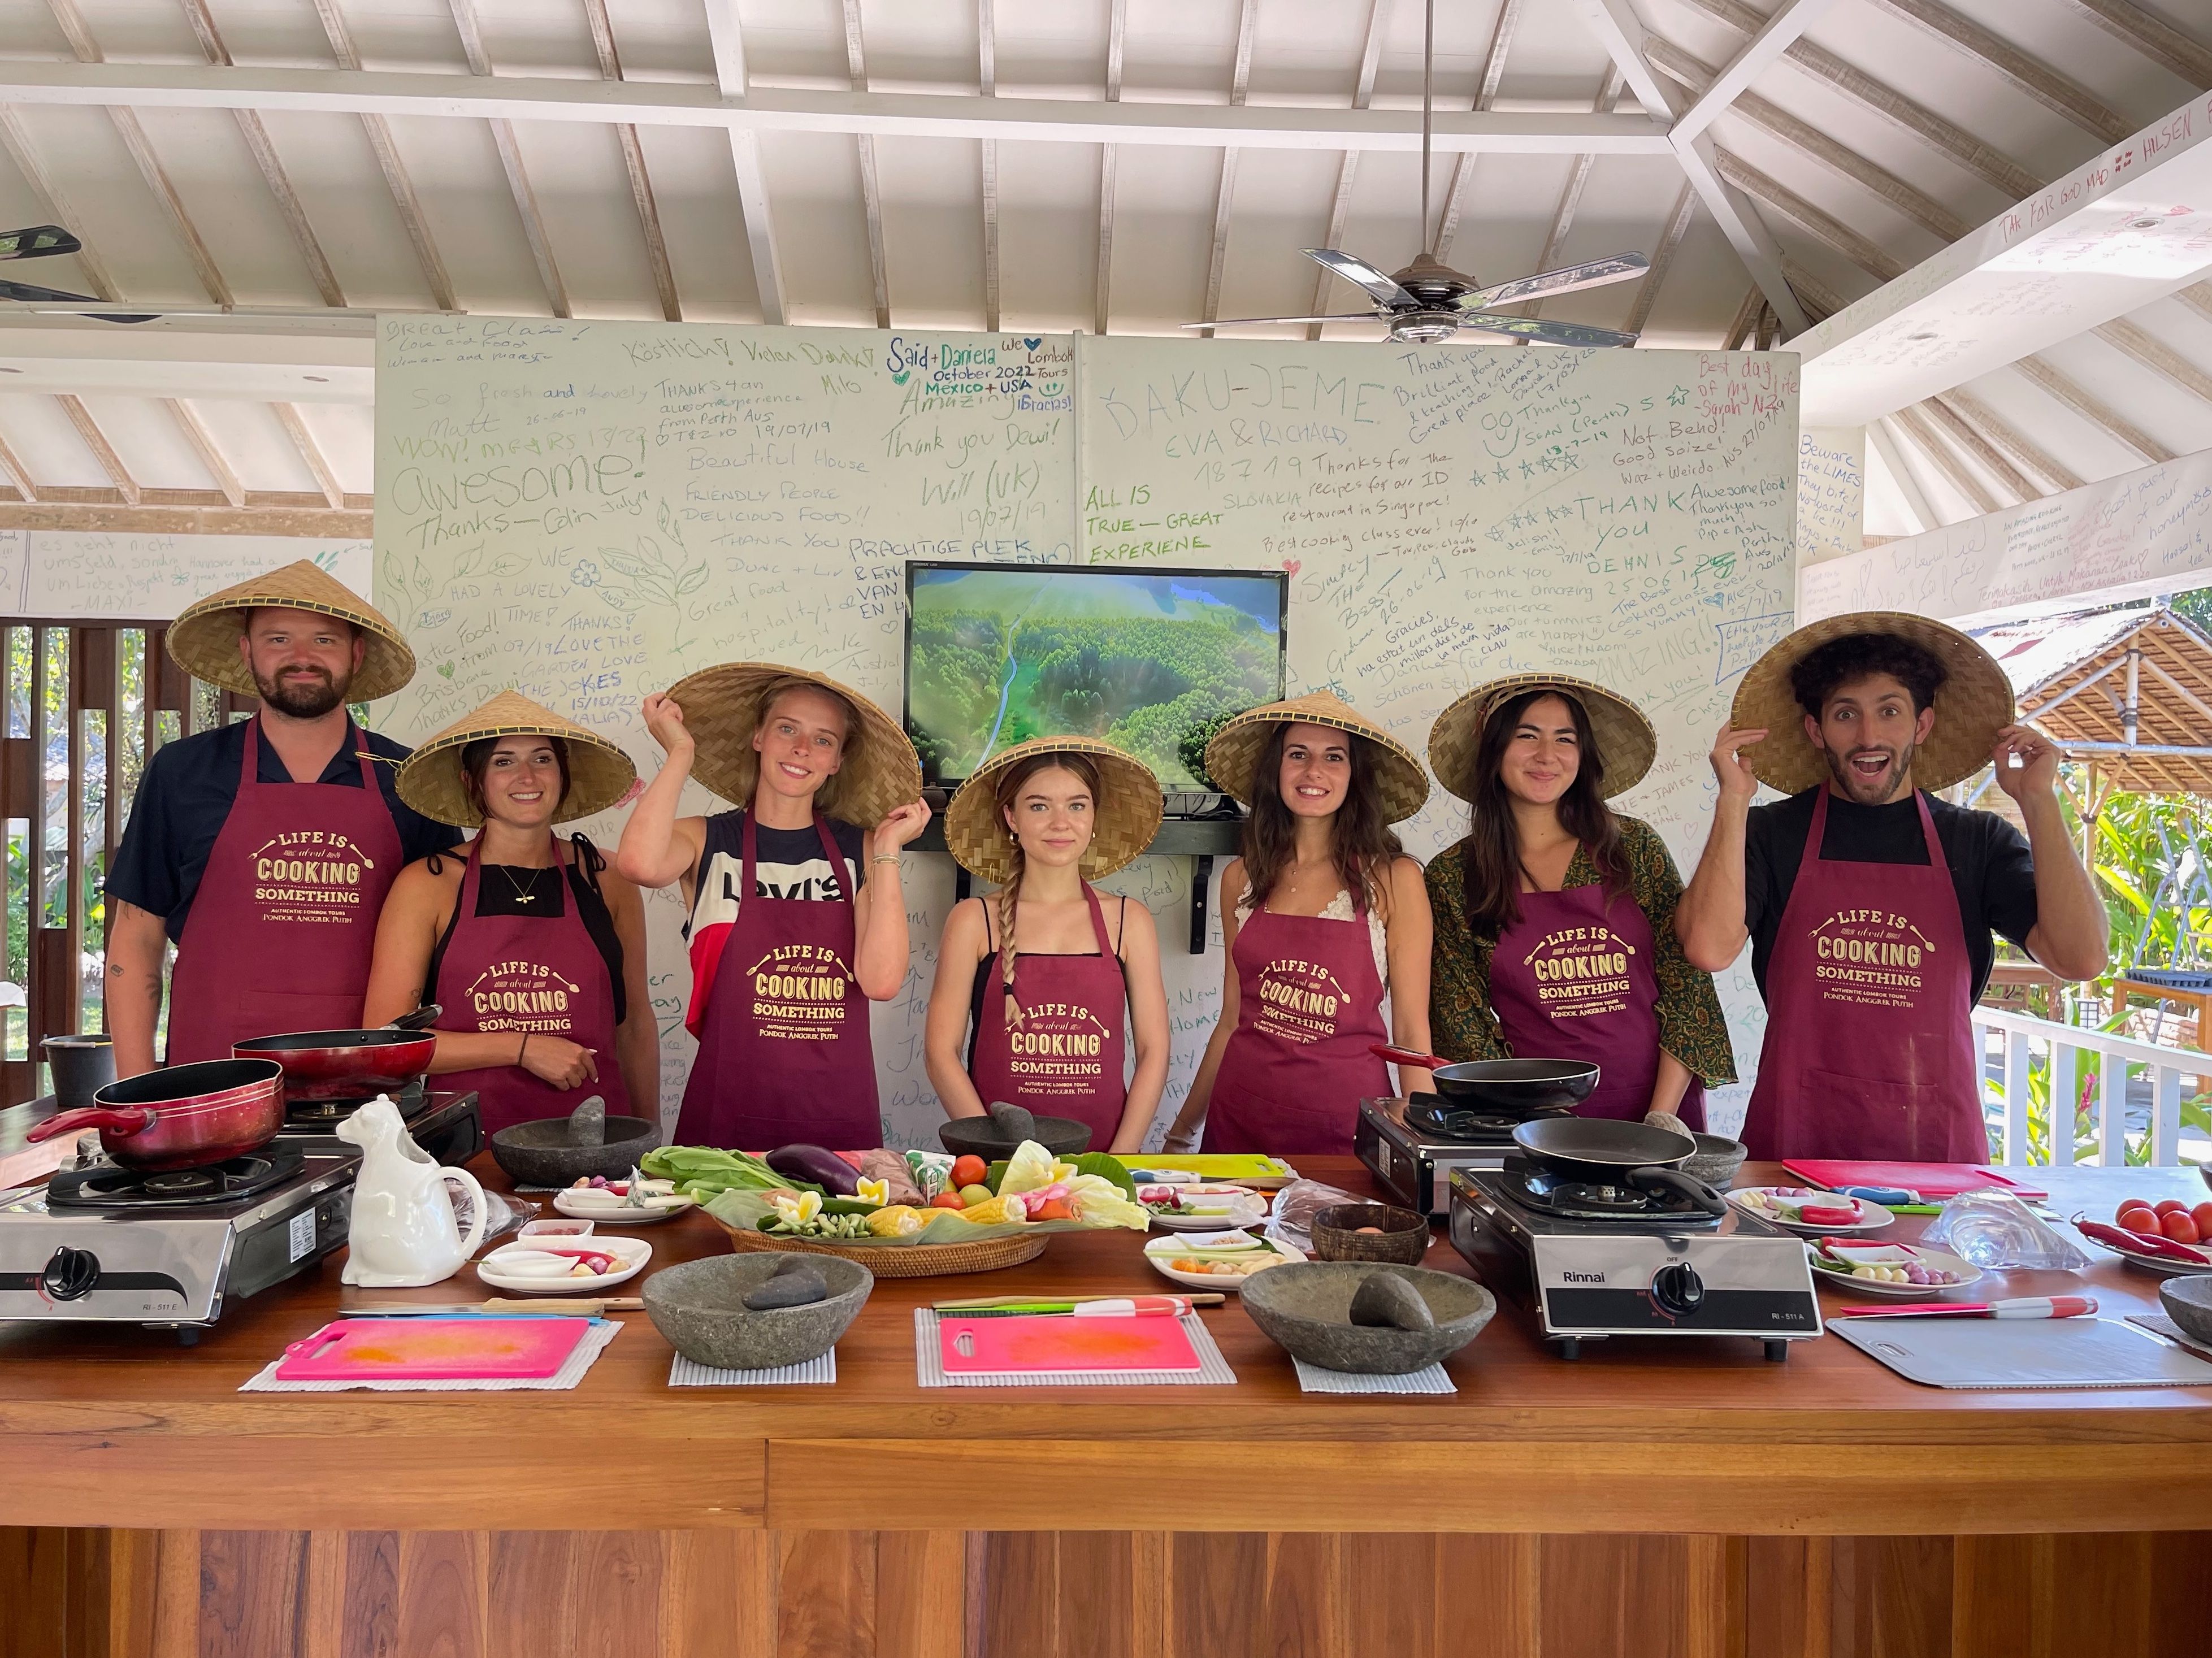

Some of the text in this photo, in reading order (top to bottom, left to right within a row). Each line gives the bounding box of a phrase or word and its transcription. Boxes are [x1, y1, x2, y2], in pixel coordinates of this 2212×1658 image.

[886, 337, 996, 373] Said Daniela
[1396, 351, 1455, 376] Thank
[933, 368, 989, 383] October
[995, 366, 1036, 379] 2022
[1699, 352, 1772, 390] Best day
[1000, 379, 1033, 393] USA
[1259, 420, 1348, 447] RICHARD
[1799, 434, 1858, 468] Beware
[1801, 457, 1820, 473] the
[1084, 484, 1151, 511] ALL IS
[1573, 490, 1686, 521] THANK
[1798, 491, 1810, 505] No
[1086, 511, 1225, 536] TRUE GREAT
[856, 582, 898, 601] VAN
[279, 831, 348, 848] LIFE IS
[258, 858, 360, 885] COOKING
[255, 888, 359, 903] SOMETHING
[1837, 909, 1907, 929] LIFE IS
[1546, 927, 1608, 946] LIFE IS
[773, 945, 834, 962] LIFE IS
[1567, 944, 1591, 954] about
[1818, 936, 1921, 968] COOKING
[489, 961, 550, 978] LIFE IS
[791, 962, 814, 973] about
[1271, 960, 1329, 980] LIFE IS
[1534, 953, 1627, 981] COOKING
[1816, 966, 1921, 987] SOMETHING
[756, 973, 845, 1000] COOKING
[1539, 980, 1629, 999] SOMETHING
[474, 990, 568, 1014] COOKING
[1260, 979, 1338, 1017] COOKING
[753, 1002, 844, 1019] SOMETHING
[1027, 1004, 1088, 1019] LIFE IS
[1262, 1005, 1335, 1034] SOMETHING
[479, 1018, 571, 1031] SOMETHING
[760, 1029, 787, 1038] PONDOK
[1012, 1032, 1101, 1056] COOKING
[1011, 1061, 1101, 1074] SOMETHING
[1563, 1271, 1605, 1283] Rinnai
